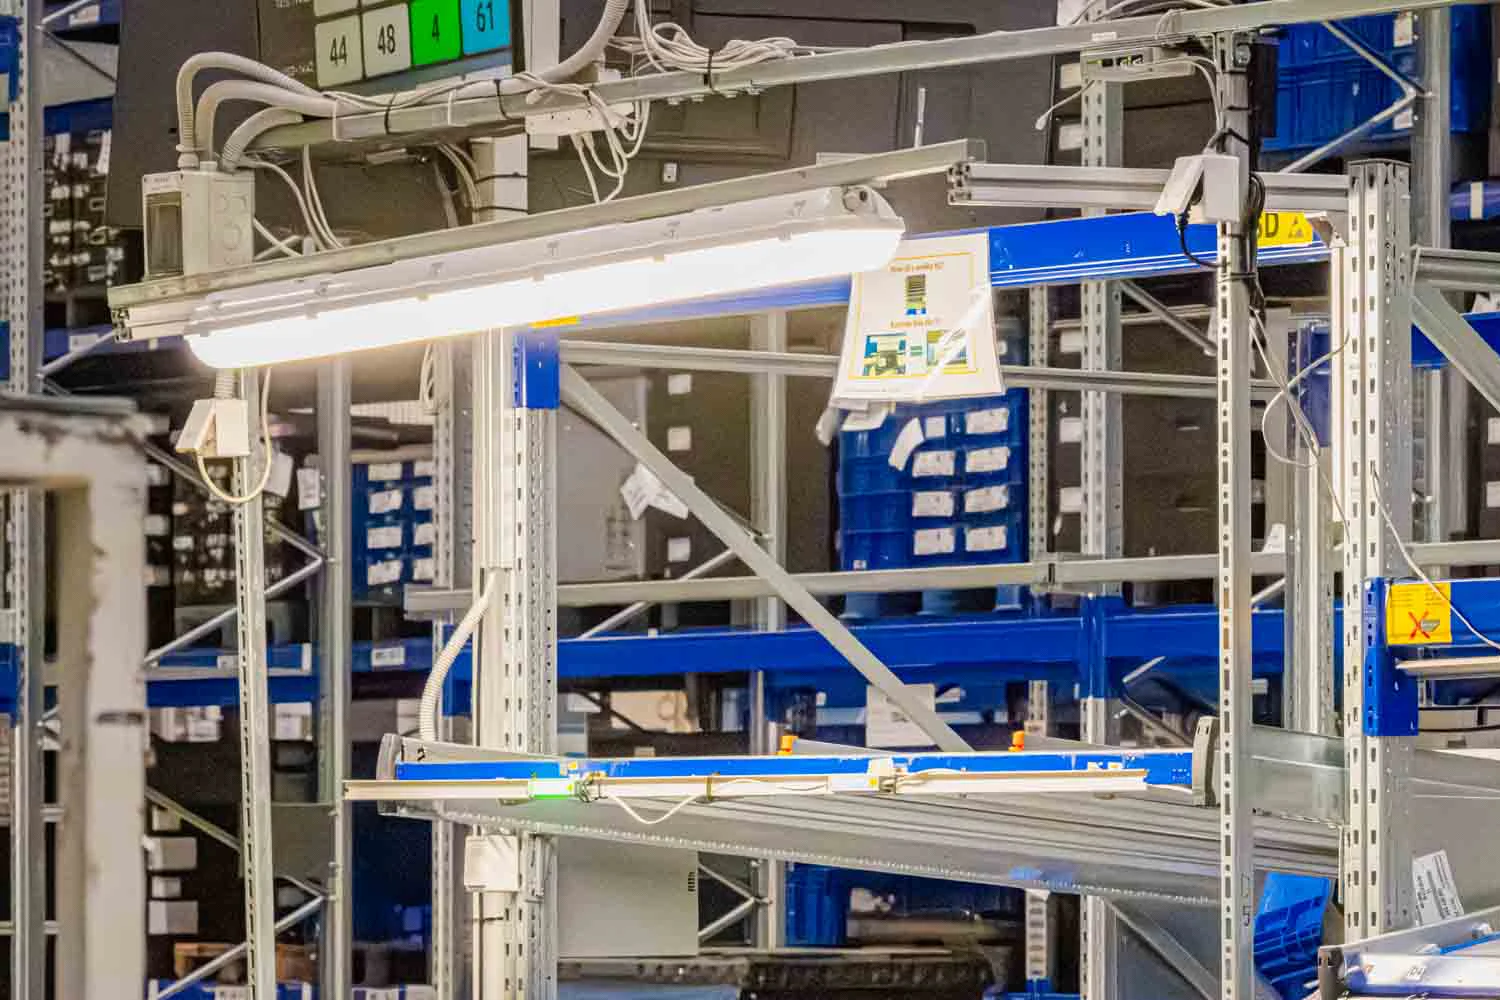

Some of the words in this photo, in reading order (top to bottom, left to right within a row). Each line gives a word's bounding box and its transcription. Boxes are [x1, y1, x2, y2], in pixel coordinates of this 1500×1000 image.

[431, 14, 440, 43] 4
[476, 2, 494, 32] 61
[330, 35, 347, 67] 44
[377, 24, 396, 56] 48
